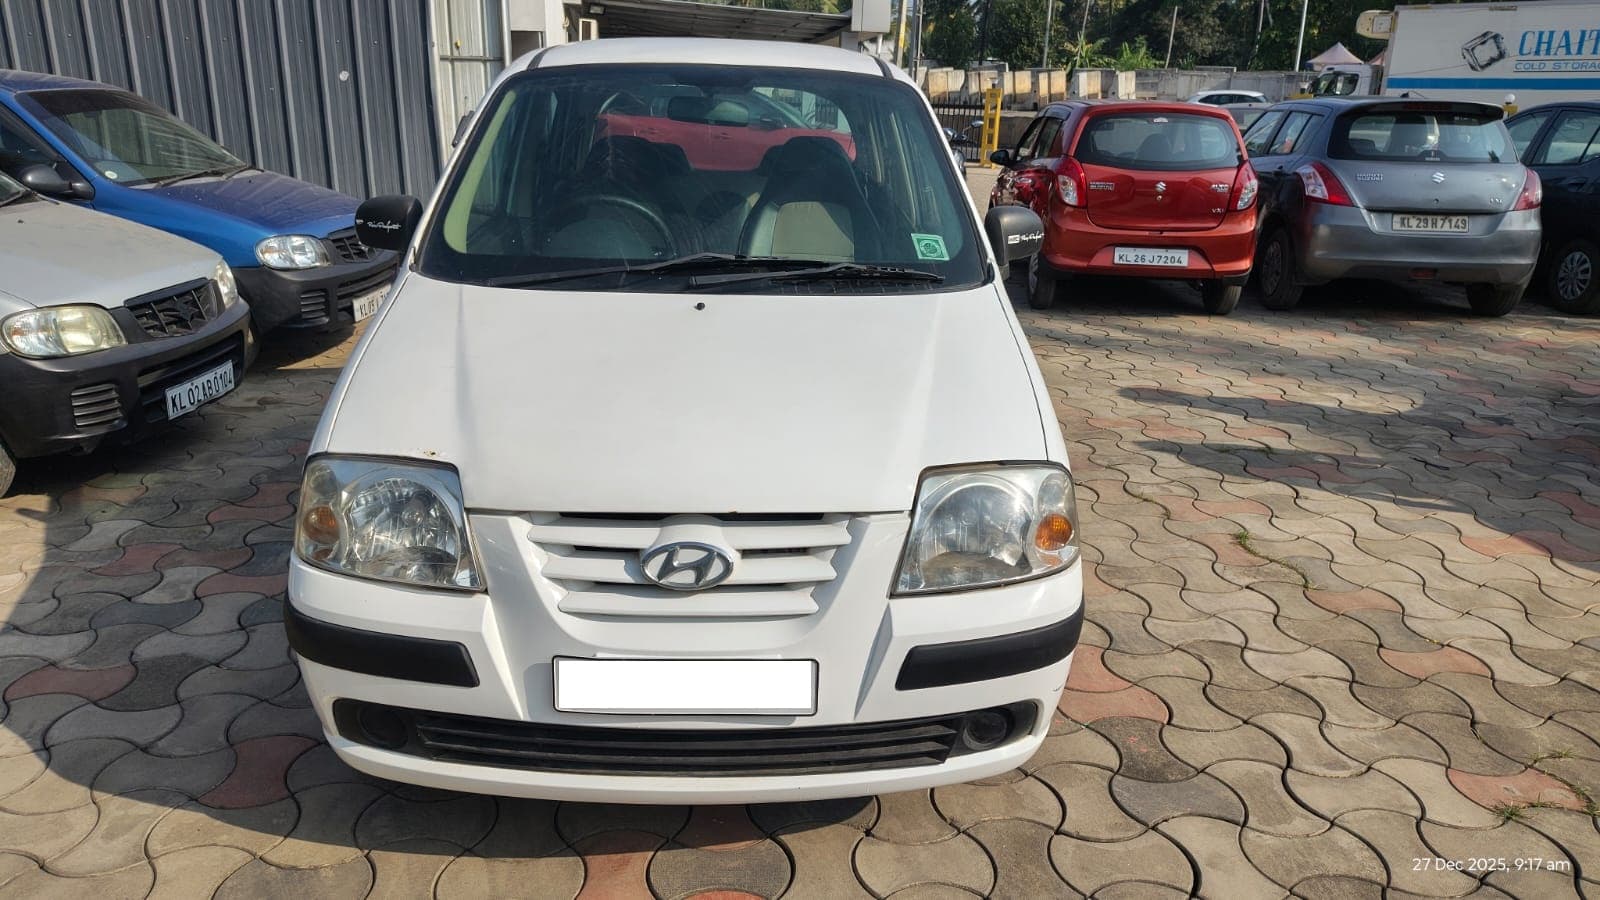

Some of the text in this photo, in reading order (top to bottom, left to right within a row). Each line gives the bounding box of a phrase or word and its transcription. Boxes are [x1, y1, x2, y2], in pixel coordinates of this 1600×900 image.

[1514, 62, 1546, 70] COLD
[1400, 216, 1413, 228] KL
[1415, 217, 1429, 229] 29
[1118, 254, 1131, 262] KL
[1134, 255, 1146, 263] 26
[171, 392, 187, 413] KL
